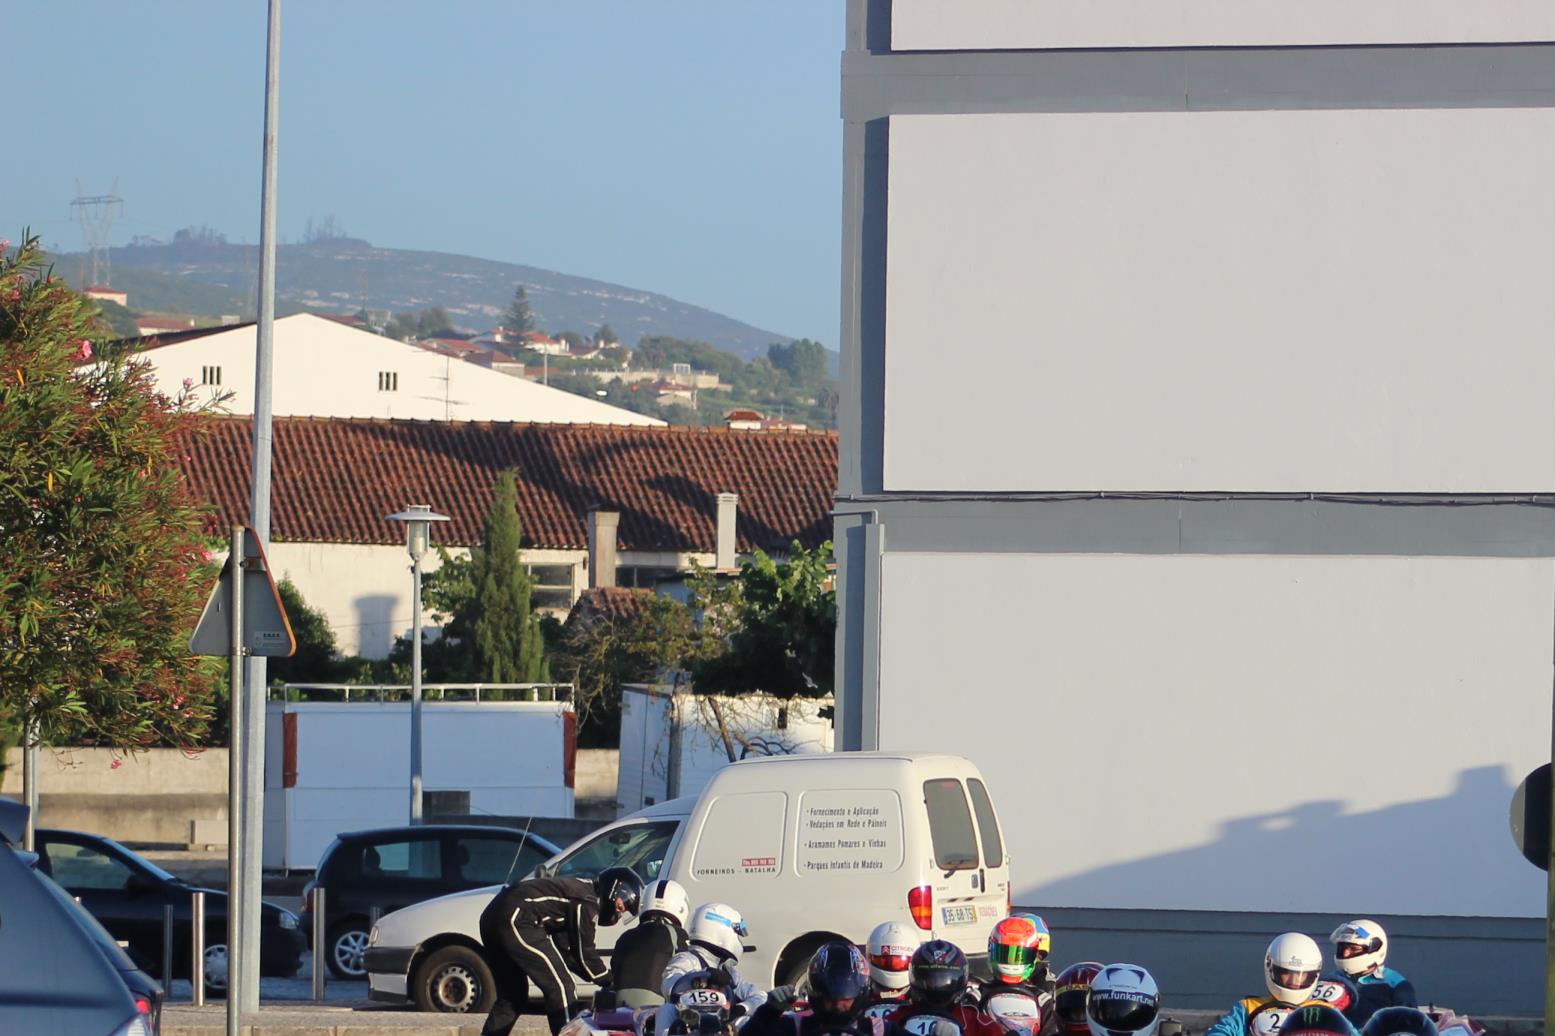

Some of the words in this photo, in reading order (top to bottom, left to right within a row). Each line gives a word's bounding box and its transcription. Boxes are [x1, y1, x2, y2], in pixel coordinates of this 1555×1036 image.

[810, 808, 845, 816] Fornecimento
[853, 807, 879, 816] Aplicação
[809, 820, 834, 830] Vedações
[847, 820, 860, 828] Rede
[868, 839, 886, 848] Vinhas
[807, 861, 828, 871] Parques
[830, 861, 851, 869] Infantis
[861, 860, 883, 869] Madeira
[688, 992, 720, 1004] 159
